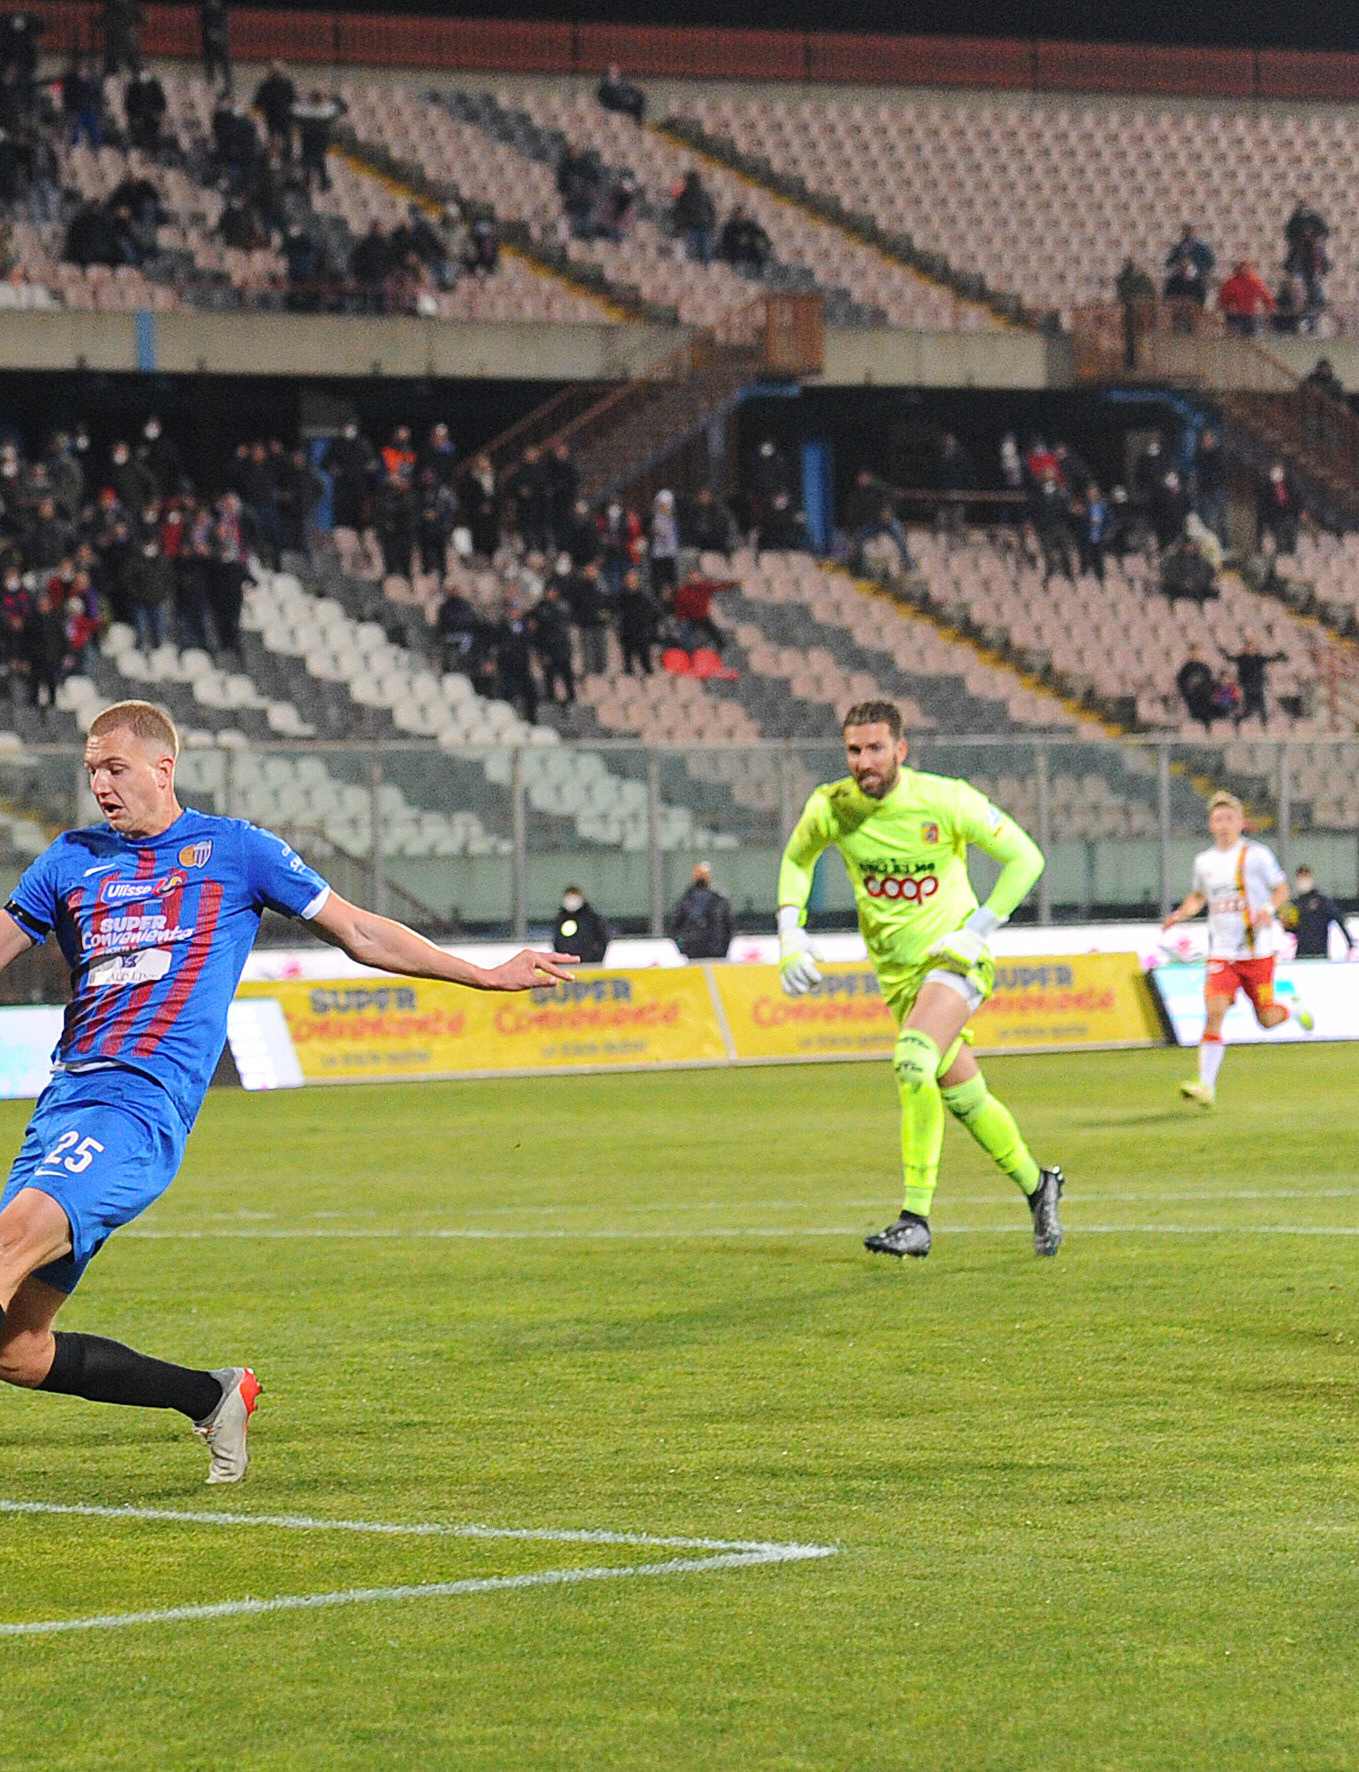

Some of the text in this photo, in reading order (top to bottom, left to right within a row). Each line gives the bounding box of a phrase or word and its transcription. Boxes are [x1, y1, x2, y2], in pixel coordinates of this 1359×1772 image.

[106, 883, 153, 898] Ulisse
[863, 874, 939, 906] coop
[99, 914, 167, 933] SUPER
[82, 925, 196, 951] Conveniente
[310, 987, 418, 1015] SUPER
[44, 1130, 105, 1173] 25
